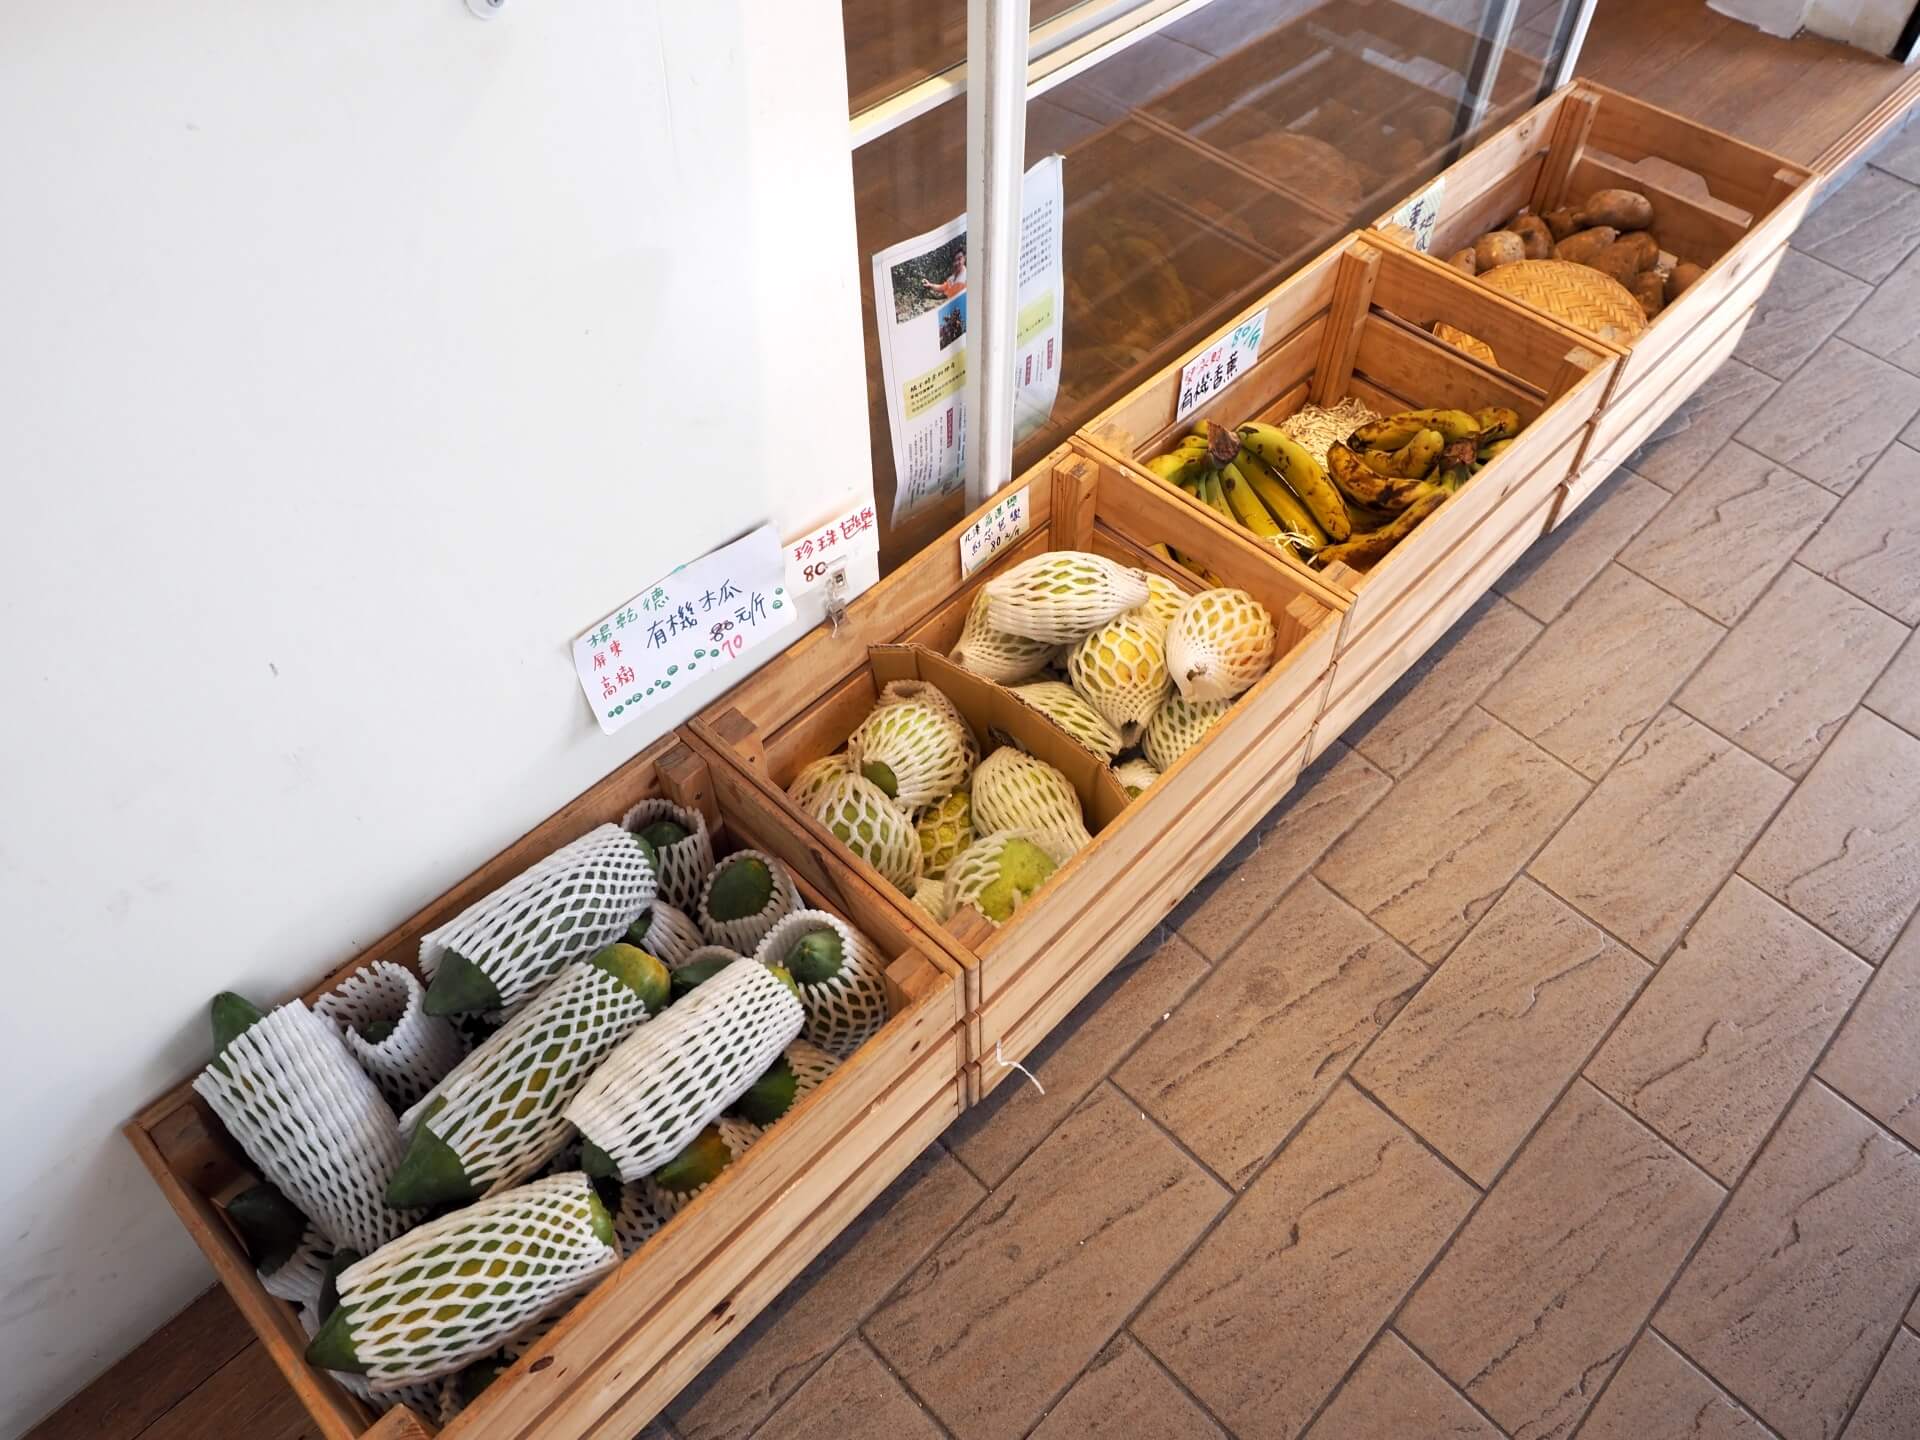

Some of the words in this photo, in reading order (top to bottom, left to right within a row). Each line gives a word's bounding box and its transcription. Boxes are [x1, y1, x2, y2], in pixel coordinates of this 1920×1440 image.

[803, 561, 827, 582] 80
[646, 578, 743, 649] 有機木瓜
[592, 639, 623, 672] 屏東
[721, 634, 743, 660] 70
[599, 664, 636, 700] 高樹
